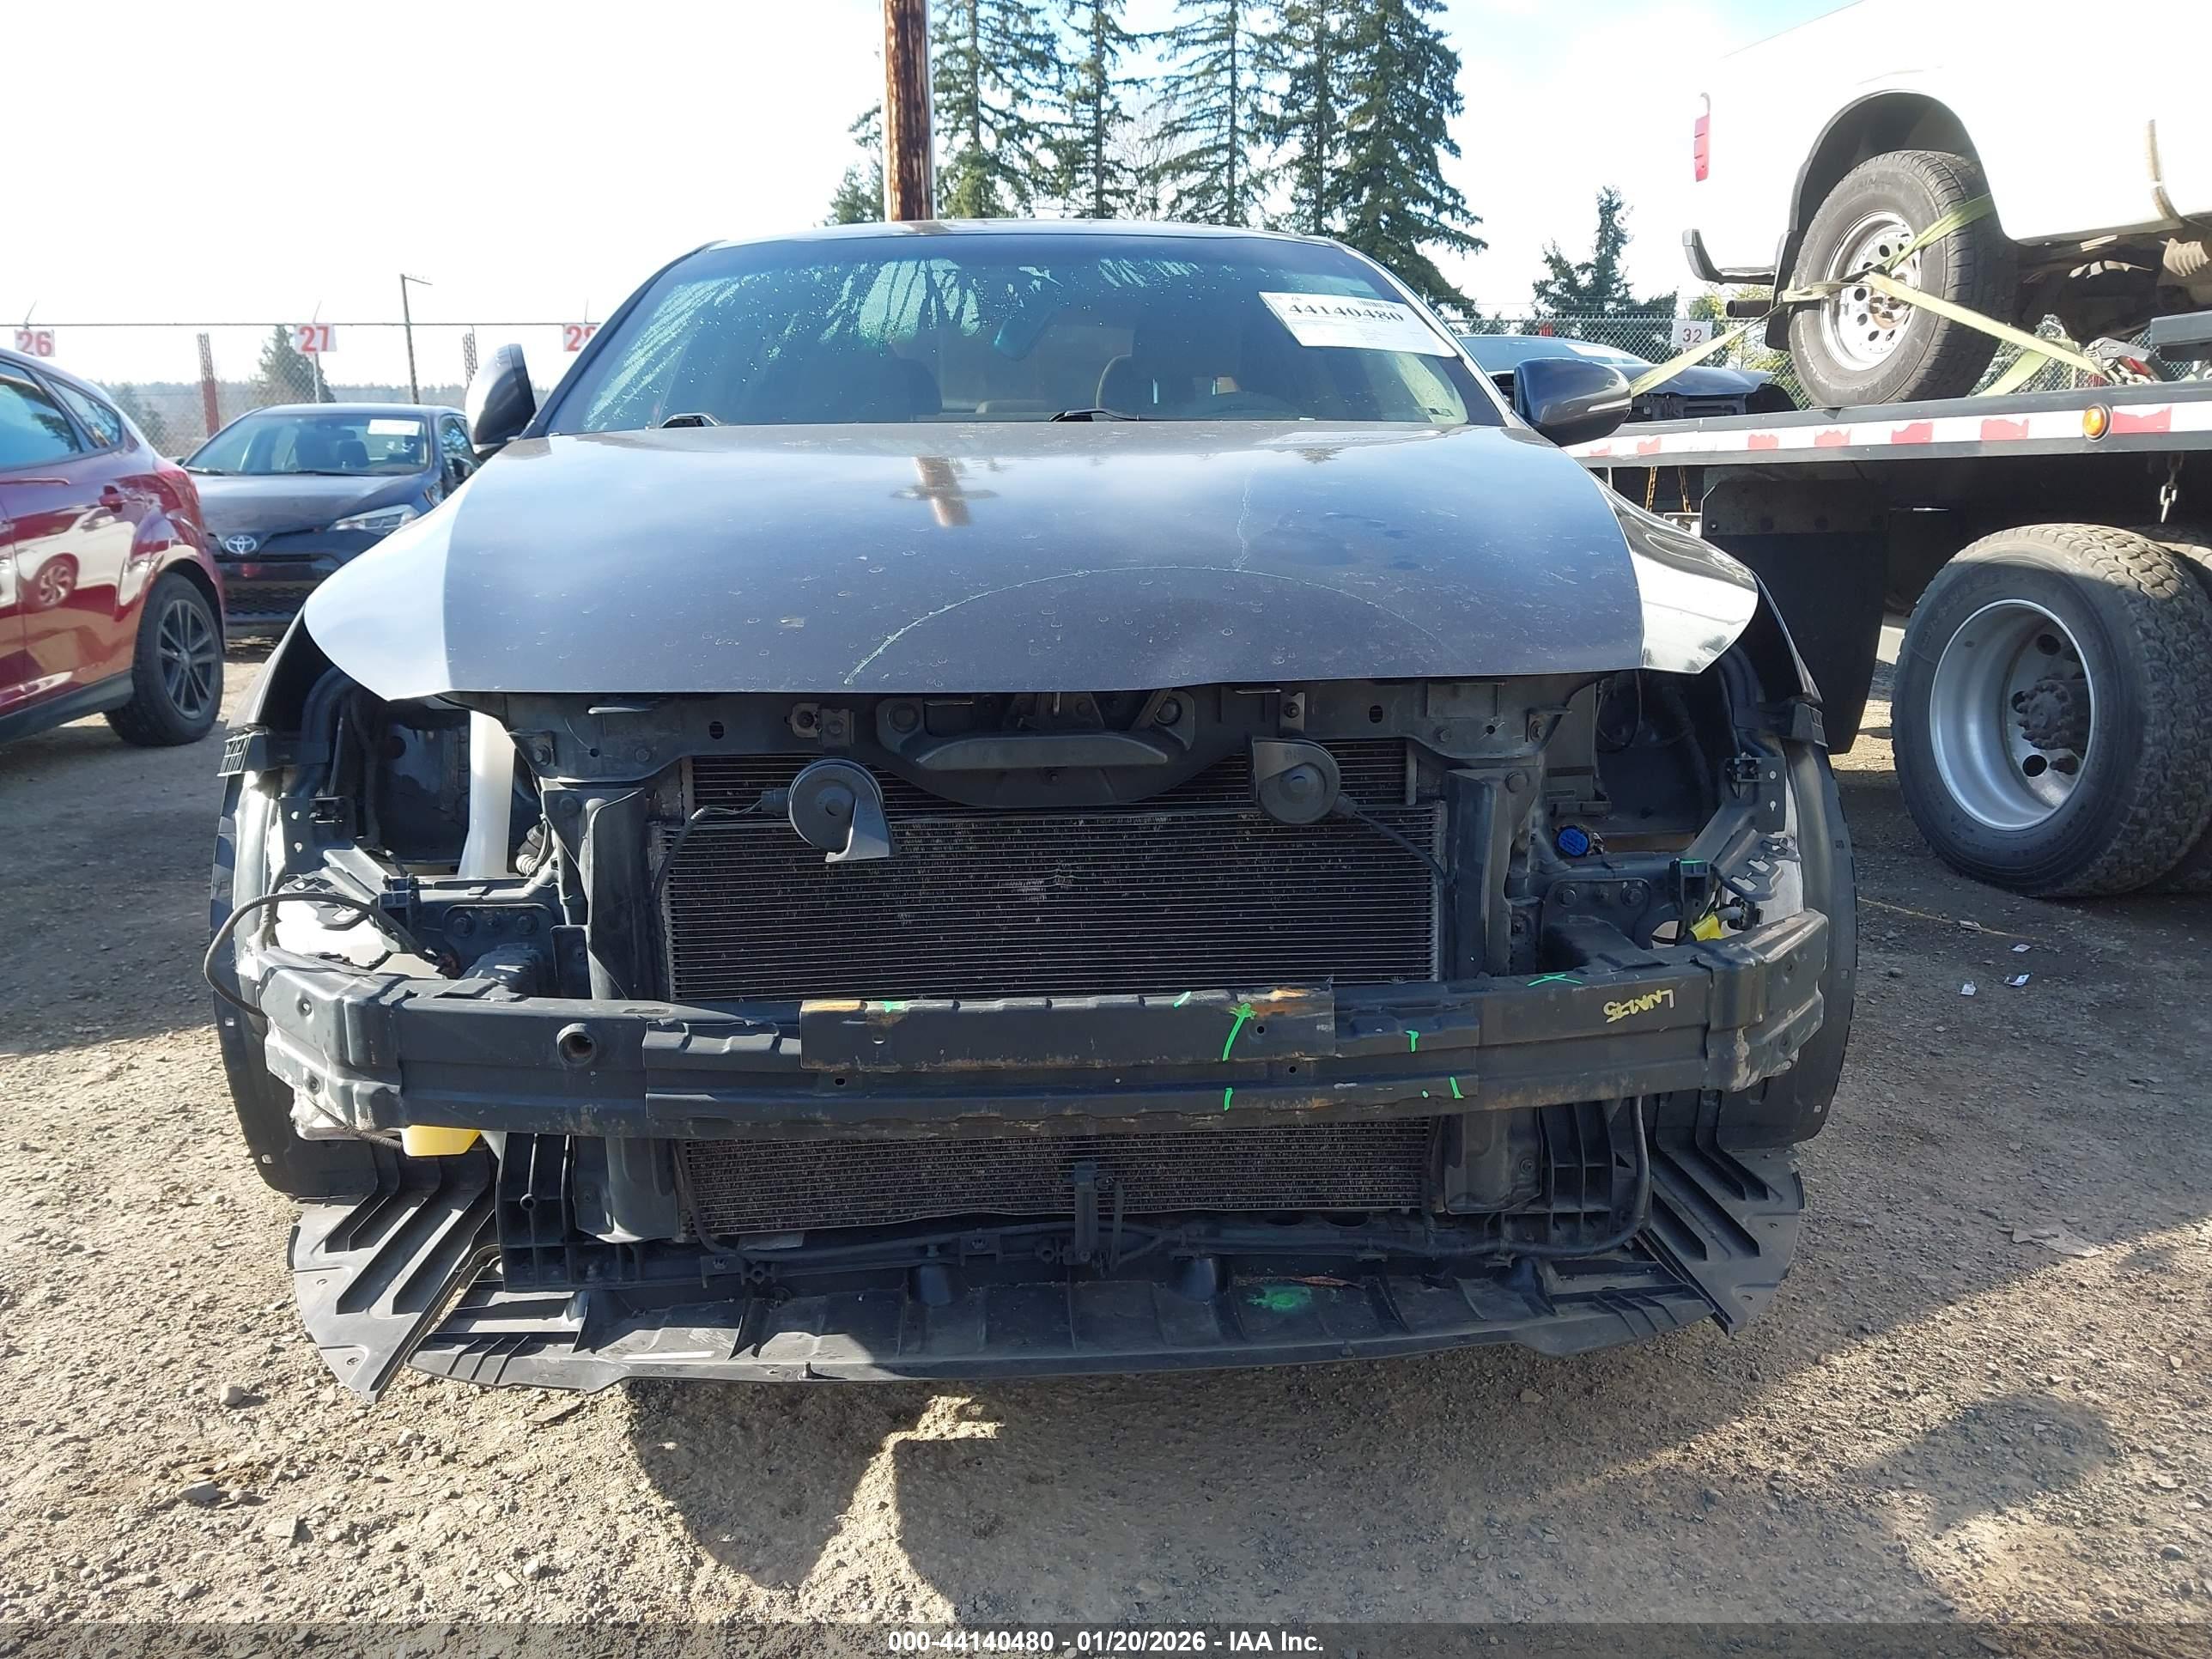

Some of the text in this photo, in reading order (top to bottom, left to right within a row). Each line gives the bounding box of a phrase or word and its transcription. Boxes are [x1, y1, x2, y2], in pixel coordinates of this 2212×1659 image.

[1288, 303, 1405, 323] 44140480
[17, 330, 52, 357] 26
[299, 325, 330, 353] 27
[1682, 327, 1702, 343] 32
